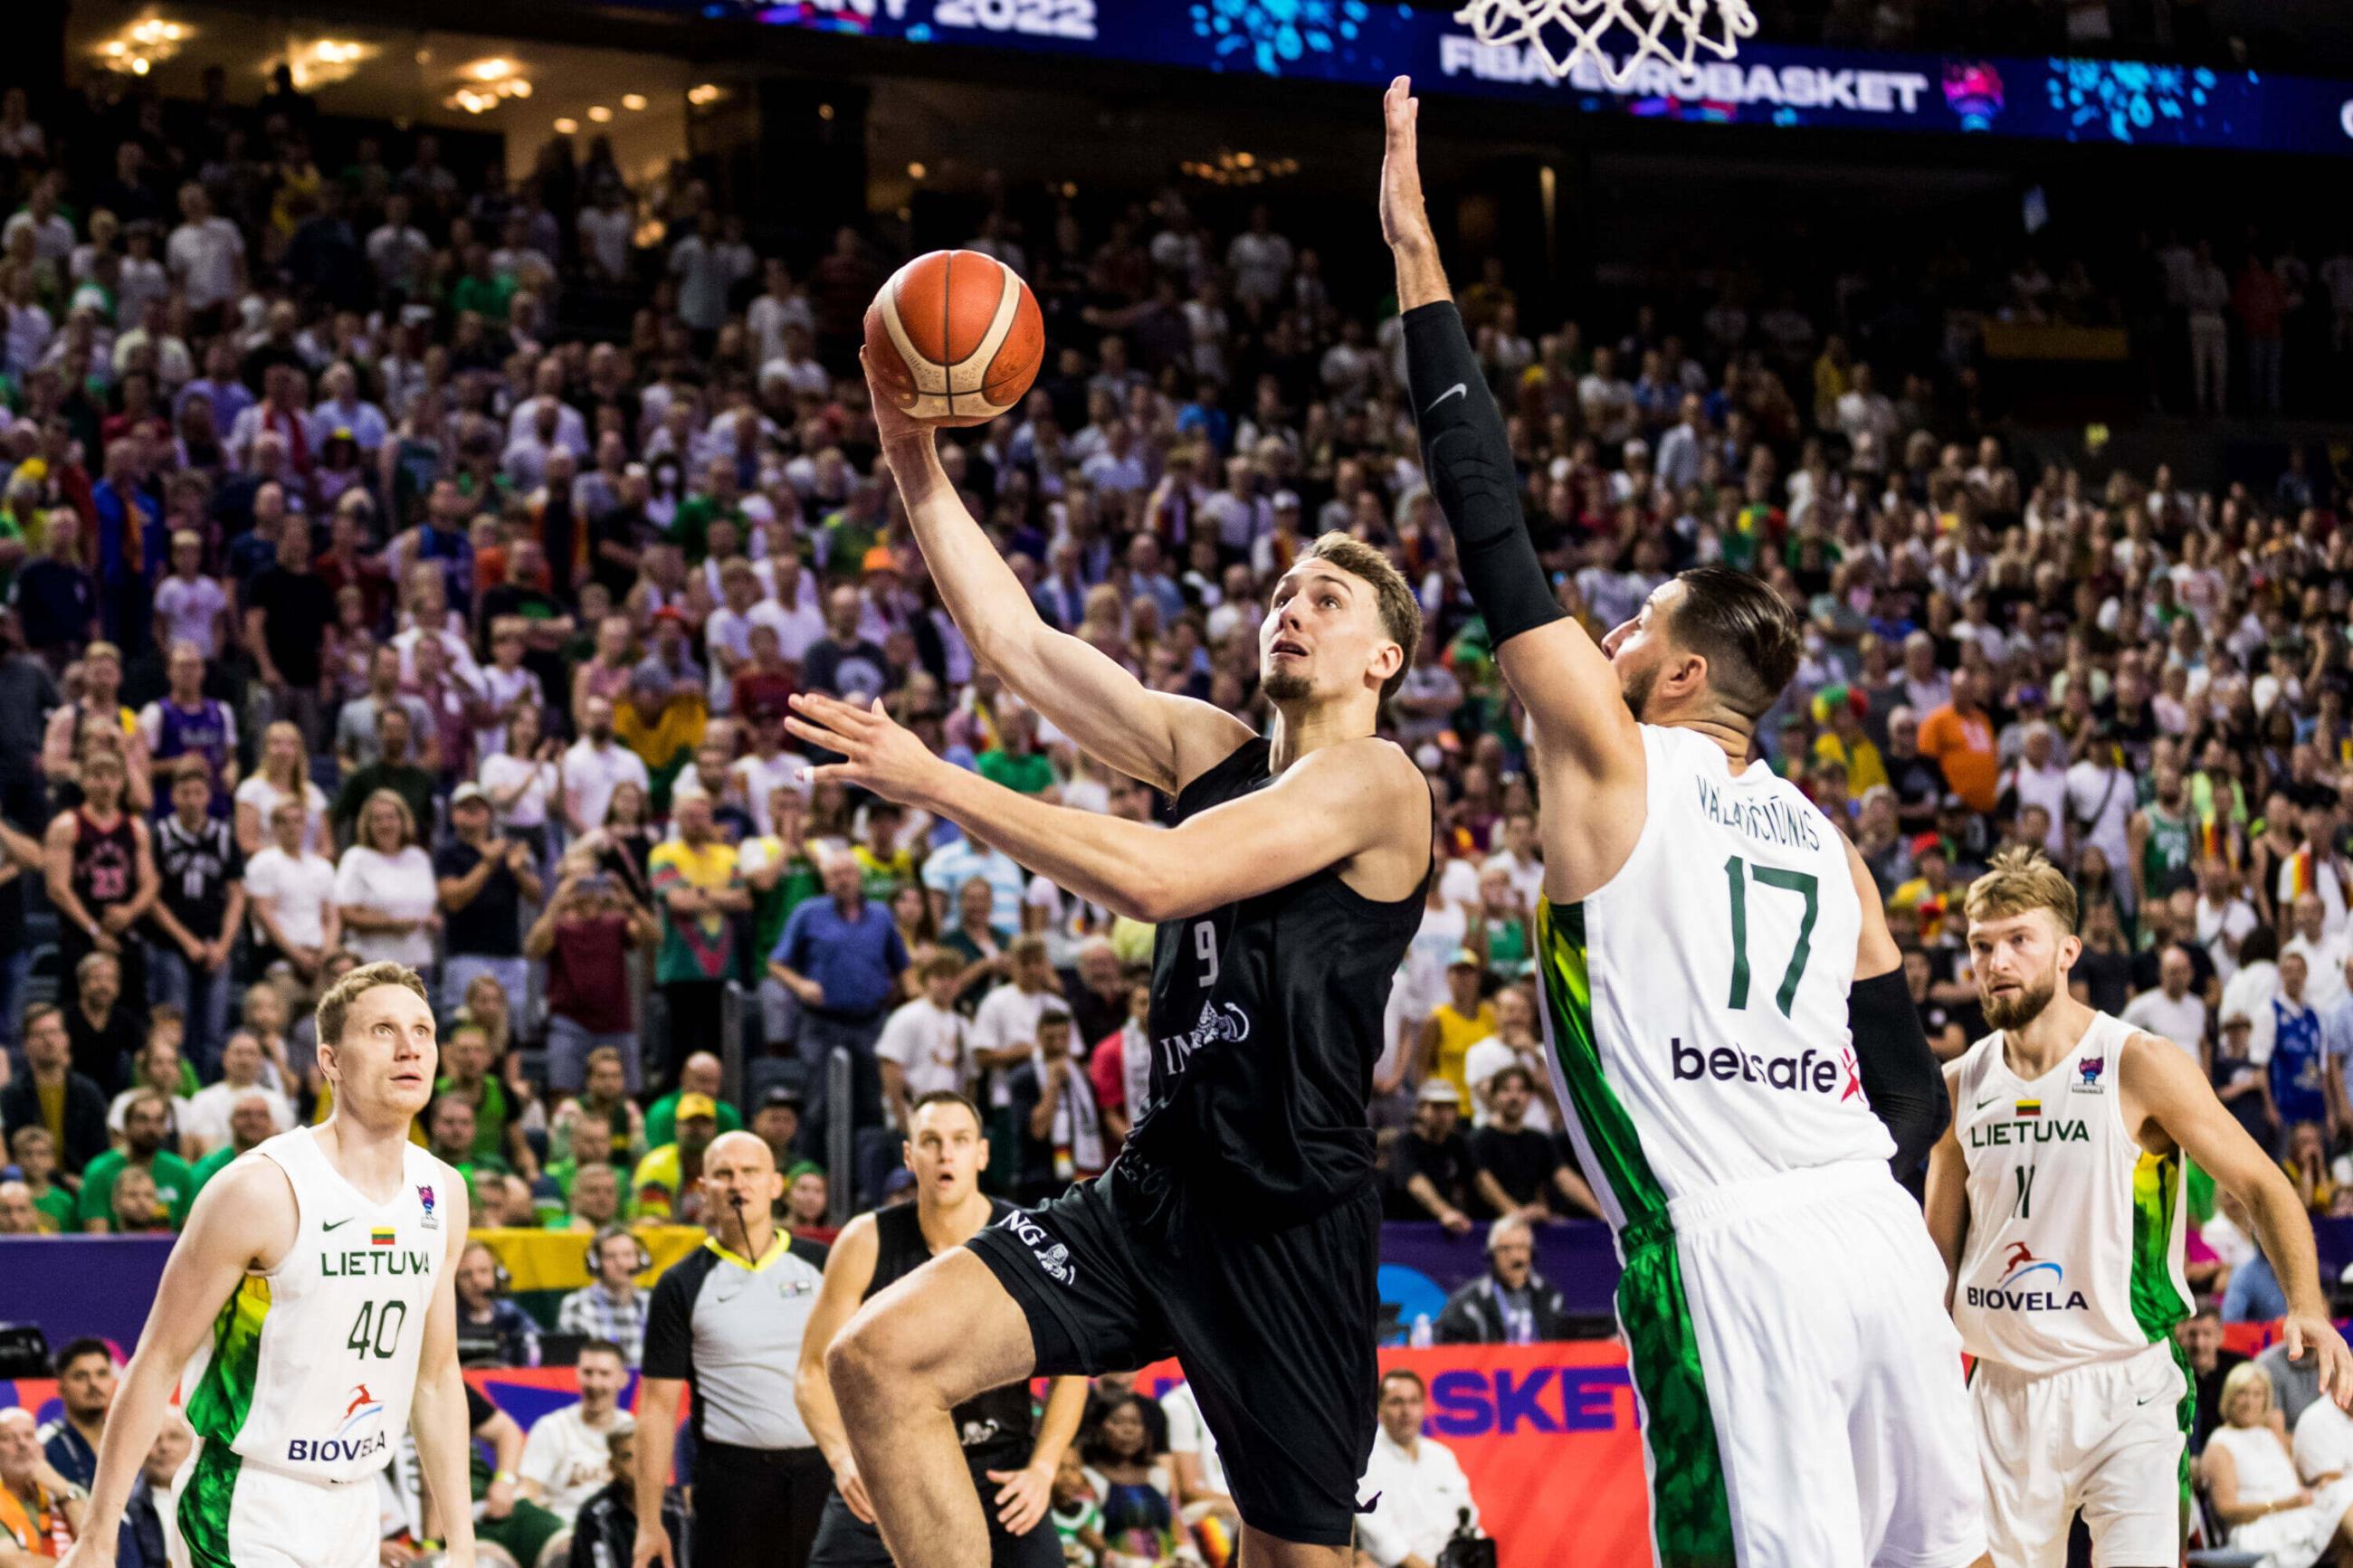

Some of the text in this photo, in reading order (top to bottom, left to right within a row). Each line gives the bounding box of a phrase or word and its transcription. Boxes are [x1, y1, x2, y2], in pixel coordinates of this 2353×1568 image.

[1194, 920, 1219, 988] 9
[1724, 854, 1819, 1020] 17
[1671, 1038, 1837, 1093] betsafe
[1970, 1120, 2091, 1148] LIETUVA
[2013, 1164, 2036, 1219] 11
[1967, 1286, 2090, 1312] BIOVELA
[348, 1300, 406, 1360] 40
[1420, 1364, 1642, 1439] SKE
